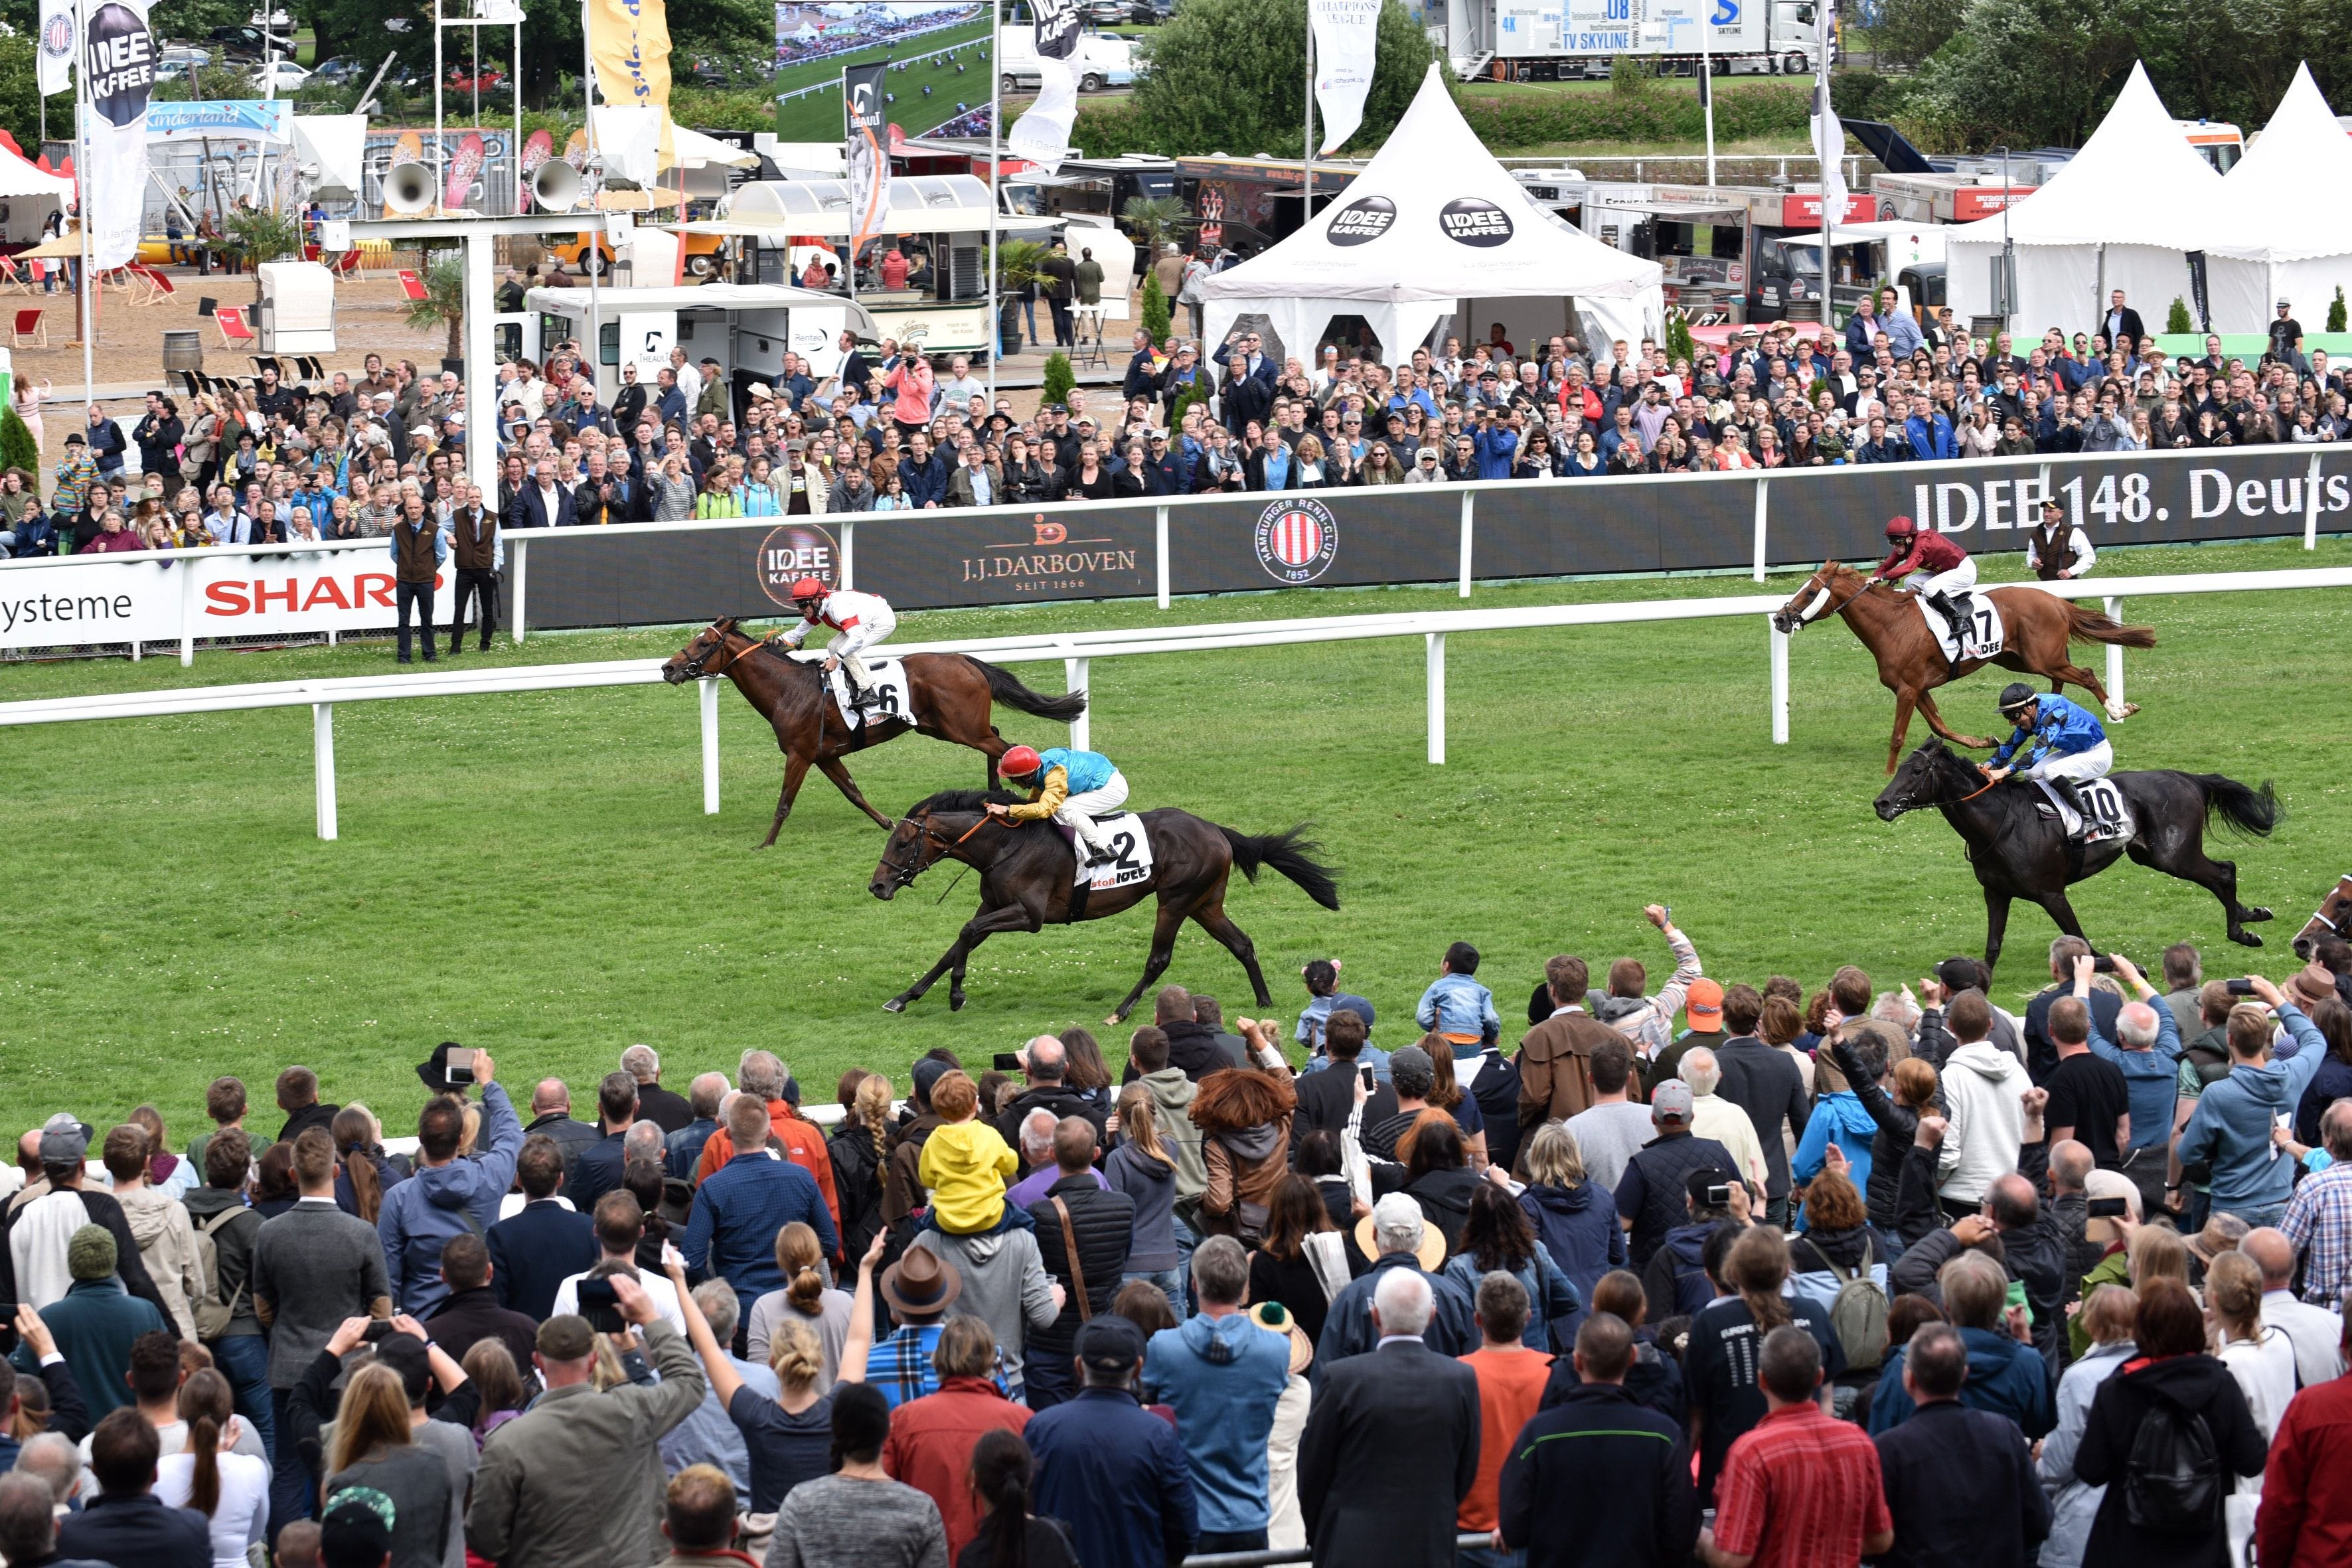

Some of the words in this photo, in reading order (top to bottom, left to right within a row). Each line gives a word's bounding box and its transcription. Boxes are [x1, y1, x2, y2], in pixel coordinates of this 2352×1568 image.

[1502, 17, 1516, 32] 4K
[1571, 12, 1601, 21] Television
[1563, 34, 1577, 49] TV
[1580, 33, 1629, 48] SKYLINE
[90, 31, 151, 76] IDEE
[145, 106, 240, 127] Kinderland
[1336, 210, 1393, 227] IDEE
[1443, 210, 1506, 228] IDEE
[1330, 224, 1383, 236] KAFFEE
[1449, 226, 1510, 238] KAFFEE
[1915, 478, 2046, 534] IDEE
[2060, 472, 2169, 524] 148.
[1257, 499, 1294, 562] HAMBURGER
[768, 547, 830, 570] IDEE
[963, 550, 1136, 582] J.J.DARBOVEN
[1285, 569, 1310, 580] 1852
[1015, 581, 1046, 591] SEIT
[1053, 579, 1085, 589] 1866
[1, 593, 132, 633] ysteme
[878, 684, 899, 714] 6
[1113, 831, 1140, 870] 2
[1091, 877, 1116, 888] stoß
[1116, 867, 1146, 884] IDEE
[1720, 1324, 1755, 1340] EUROPE
